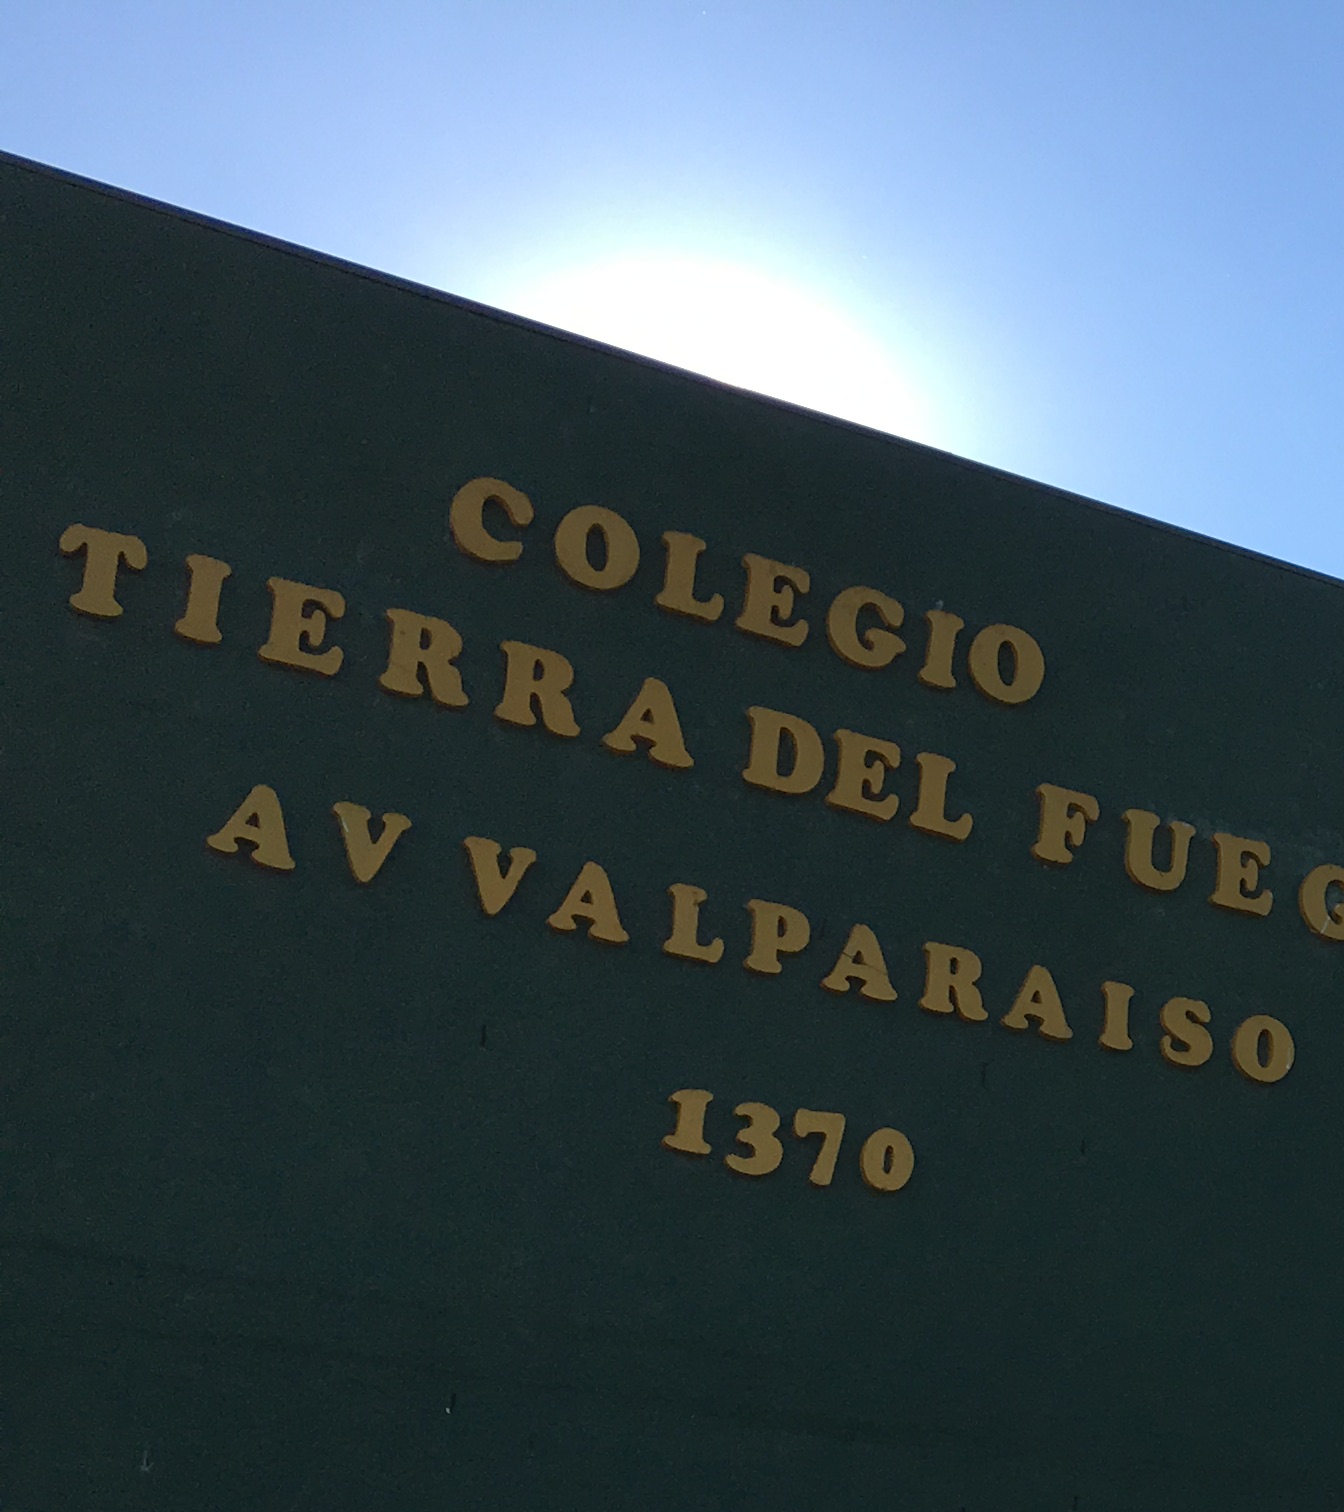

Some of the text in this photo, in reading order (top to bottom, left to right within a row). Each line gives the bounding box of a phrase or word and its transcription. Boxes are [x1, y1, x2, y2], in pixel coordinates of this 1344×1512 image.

[59, 523, 695, 769] TIERRA
[743, 706, 974, 841] DEL
[449, 476, 1045, 705] COLEGIO
[207, 784, 1296, 1084] AV VALPARAISO
[662, 1088, 915, 1193] 1370
